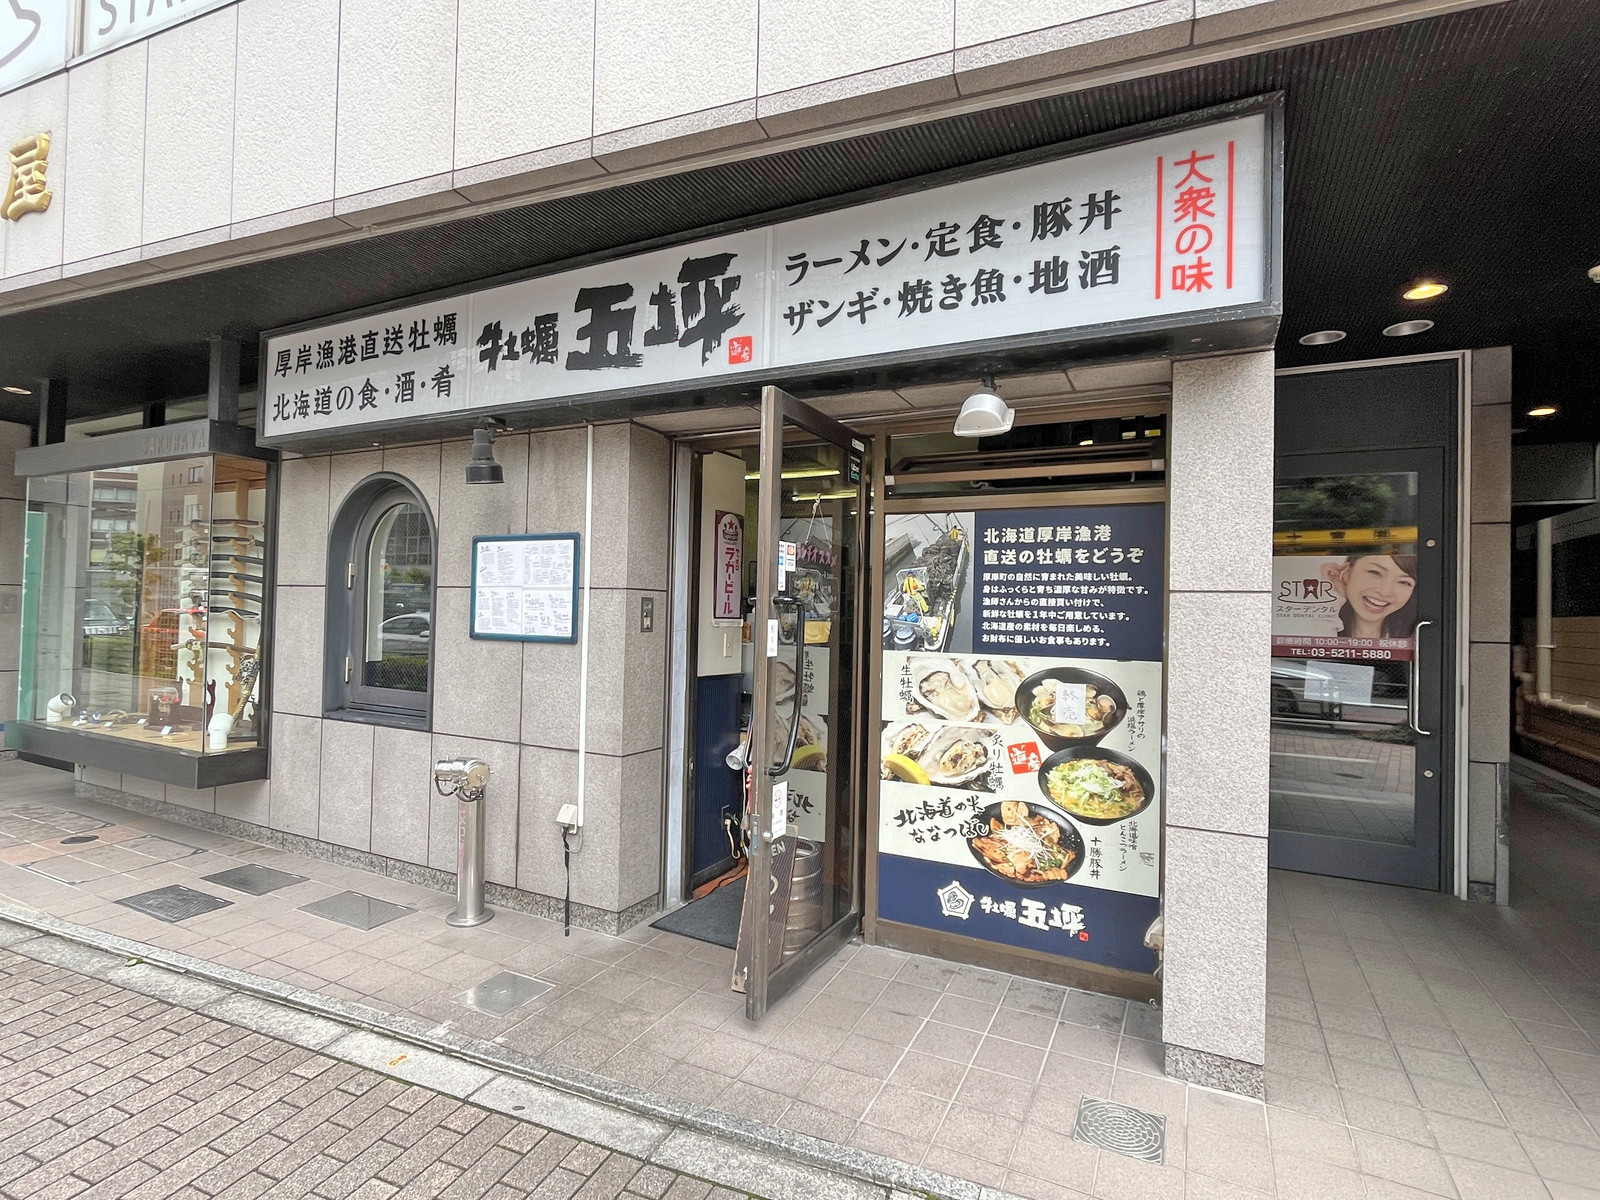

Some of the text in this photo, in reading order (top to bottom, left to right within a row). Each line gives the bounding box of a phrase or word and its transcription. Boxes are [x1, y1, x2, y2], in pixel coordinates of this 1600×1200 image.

[1, 131, 52, 222] 屋
[785, 189, 1123, 287] ラーメン・定食・豚丼
[1172, 150, 1216, 293] 大衆の味
[783, 244, 1122, 336] ザンギ・焼き魚・地酒
[274, 312, 458, 378] 厚岸漁港直送牡蠣
[272, 364, 455, 422] 北海道の食・酒・肴
[143, 429, 205, 455] SAKURAYA
[983, 524, 1112, 544] 北海道厚岸漁港
[983, 547, 1144, 565] 直送の牡蠣をどうぞ
[723, 547, 735, 615] ラガービール
[982, 572, 1133, 582] 厚岸町の自然に育まれた美味しい牡蠣。
[982, 584, 1149, 595] 身はふっくらと育ち濃厚な甘みが特徴です。
[1276, 605, 1338, 613] スターデンタル
[899, 664, 913, 702] 生牡蠣
[893, 795, 985, 828] 北海道の米
[908, 814, 990, 843] ななつぼし
